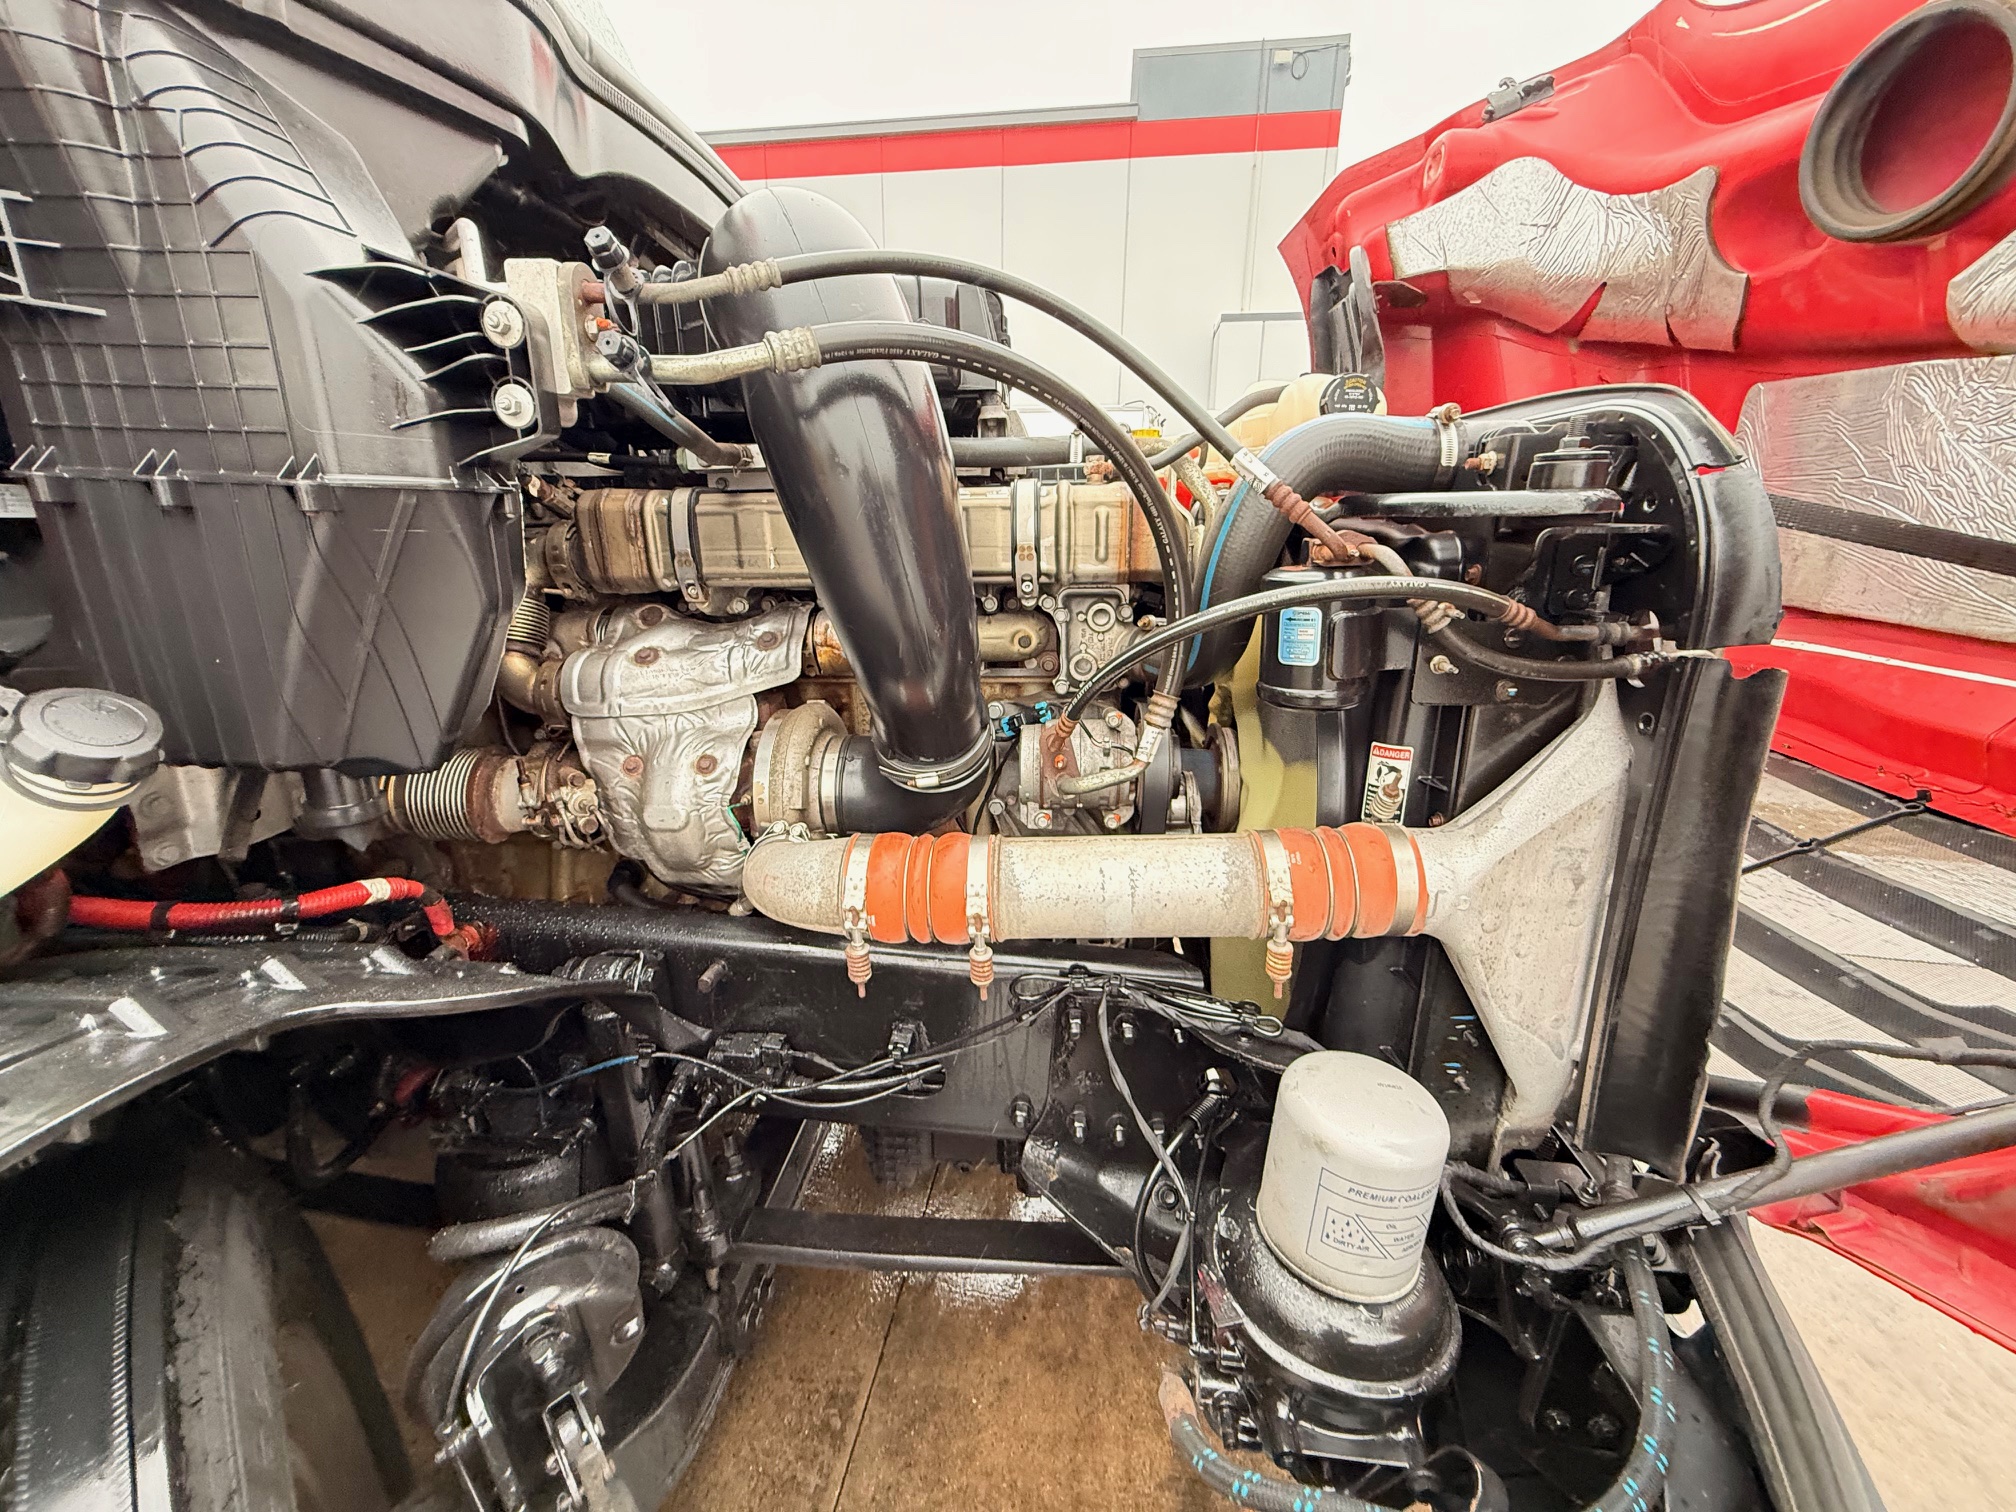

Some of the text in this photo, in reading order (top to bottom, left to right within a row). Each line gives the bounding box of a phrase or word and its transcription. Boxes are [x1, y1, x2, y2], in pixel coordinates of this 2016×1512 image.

[905, 348, 939, 359] GALAXY
[1154, 517, 1169, 544] GALAXY
[1388, 580, 1427, 588] GALAXY
[1074, 679, 1093, 700] GALAXY
[1379, 749, 1411, 760] DANGER
[1347, 1186, 1397, 1203] PREMIUM
[1332, 1236, 1370, 1252] DIRTY AIR
[1393, 1233, 1415, 1243] WATER
